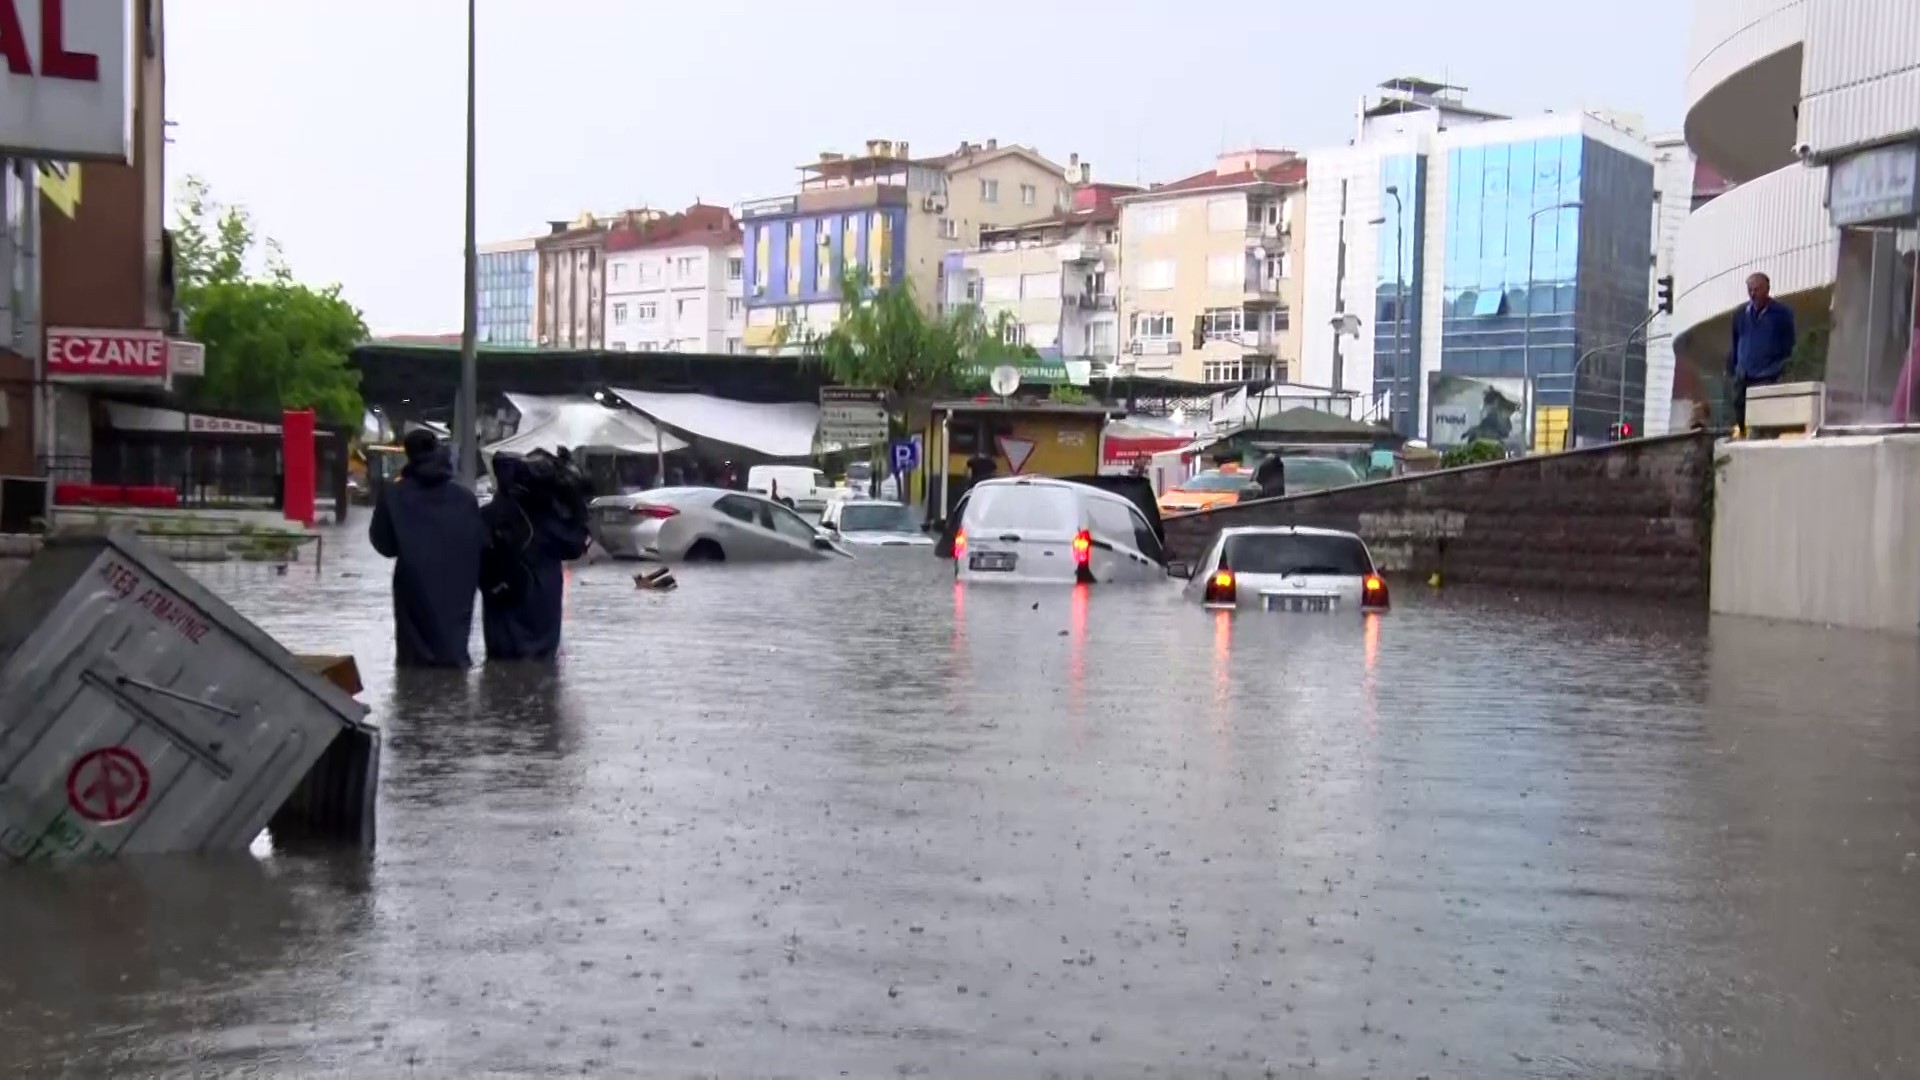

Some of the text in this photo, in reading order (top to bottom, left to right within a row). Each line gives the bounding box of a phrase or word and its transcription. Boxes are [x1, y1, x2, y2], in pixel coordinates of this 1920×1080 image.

[47, 337, 163, 367] ECZANE
[1435, 412, 1467, 425] mavi
[895, 444, 911, 469] P
